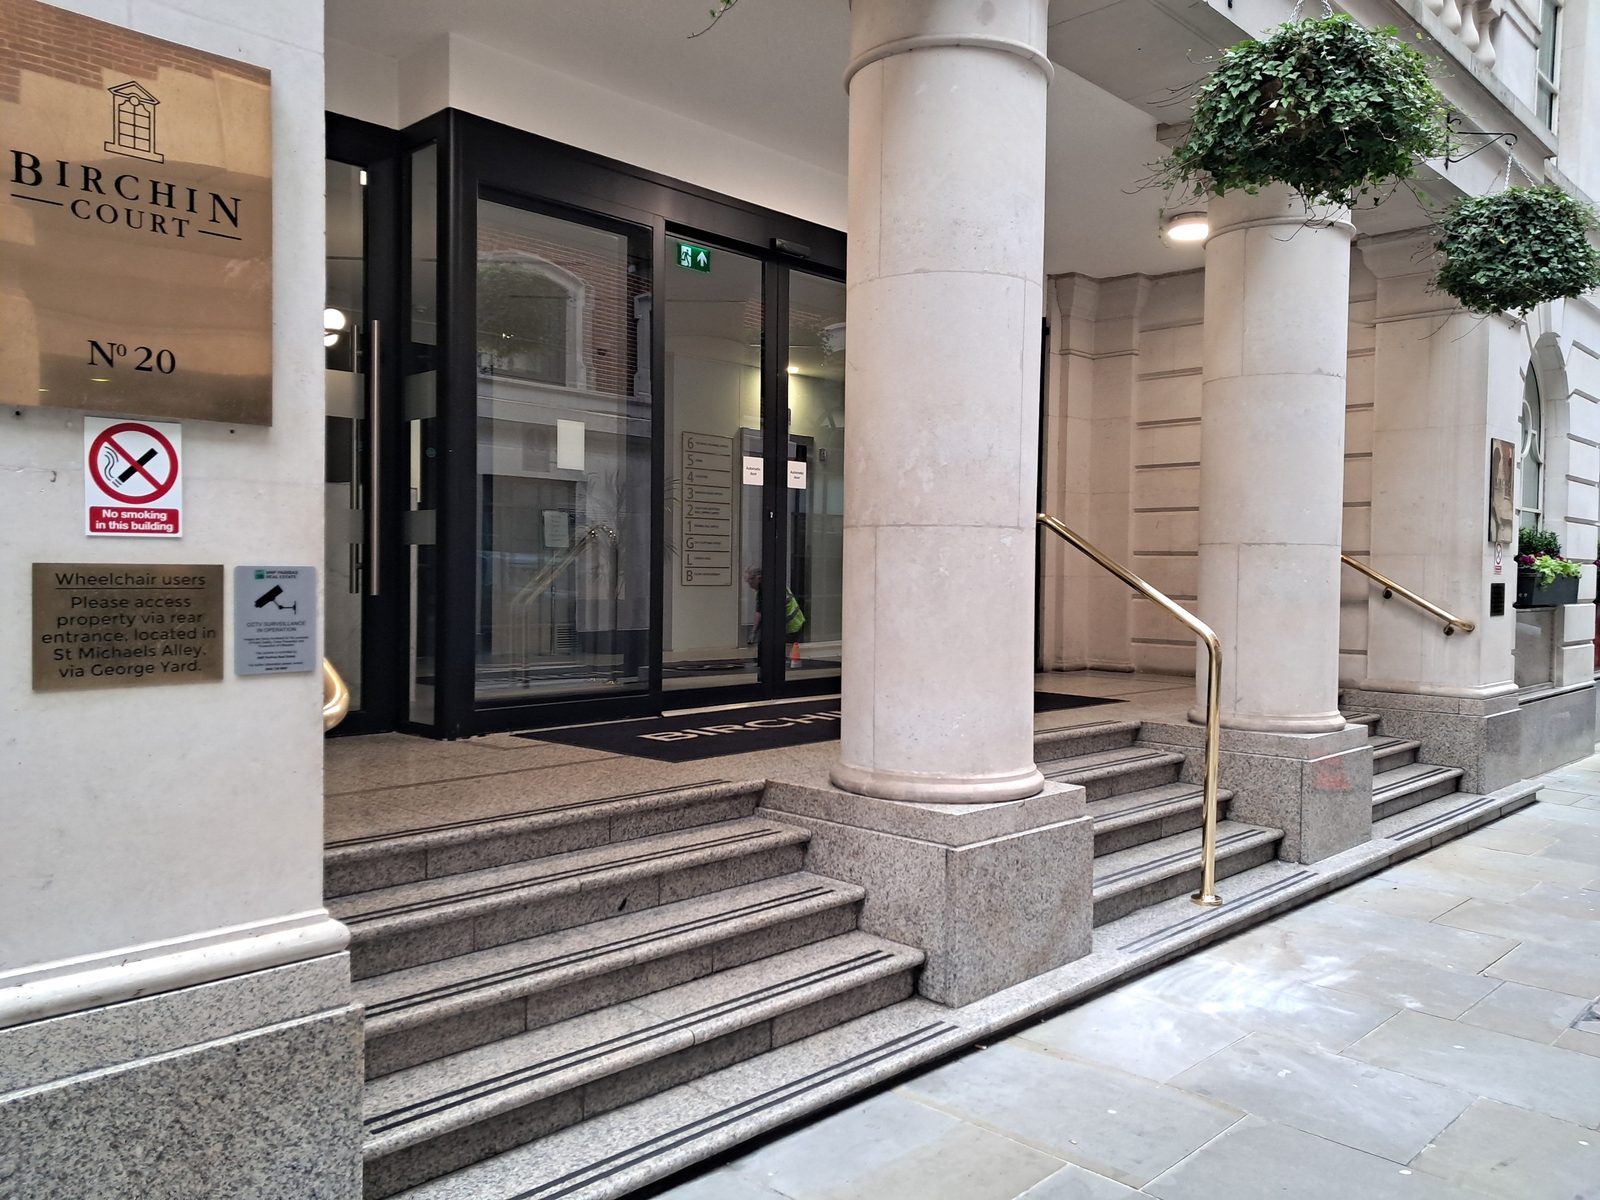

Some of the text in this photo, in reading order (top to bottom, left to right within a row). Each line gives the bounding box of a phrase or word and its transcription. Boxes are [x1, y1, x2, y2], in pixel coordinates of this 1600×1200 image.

[10, 149, 242, 229] BIRCHIN
[70, 199, 190, 238] COURT
[134, 346, 177, 374] 20
[687, 437, 694, 449] 6
[687, 454, 694, 466] 5
[687, 471, 694, 483] 4
[687, 488, 694, 499] 3
[102, 509, 168, 521] No smoking
[687, 504, 694, 516] 2
[95, 520, 174, 533] in this building
[687, 520, 692, 532] 1
[686, 537, 695, 549] G
[686, 554, 692, 565] L
[55, 572, 207, 586] Wheelchair users
[686, 570, 693, 582] B
[70, 597, 191, 609] Please access
[57, 611, 205, 629] property via rear
[134, 627, 197, 641] located
[202, 626, 217, 639] in
[53, 648, 73, 661] St
[78, 646, 157, 660] Michaels
[58, 664, 85, 678] via
[90, 662, 155, 678] George
[637, 709, 841, 742] BIRCHI
